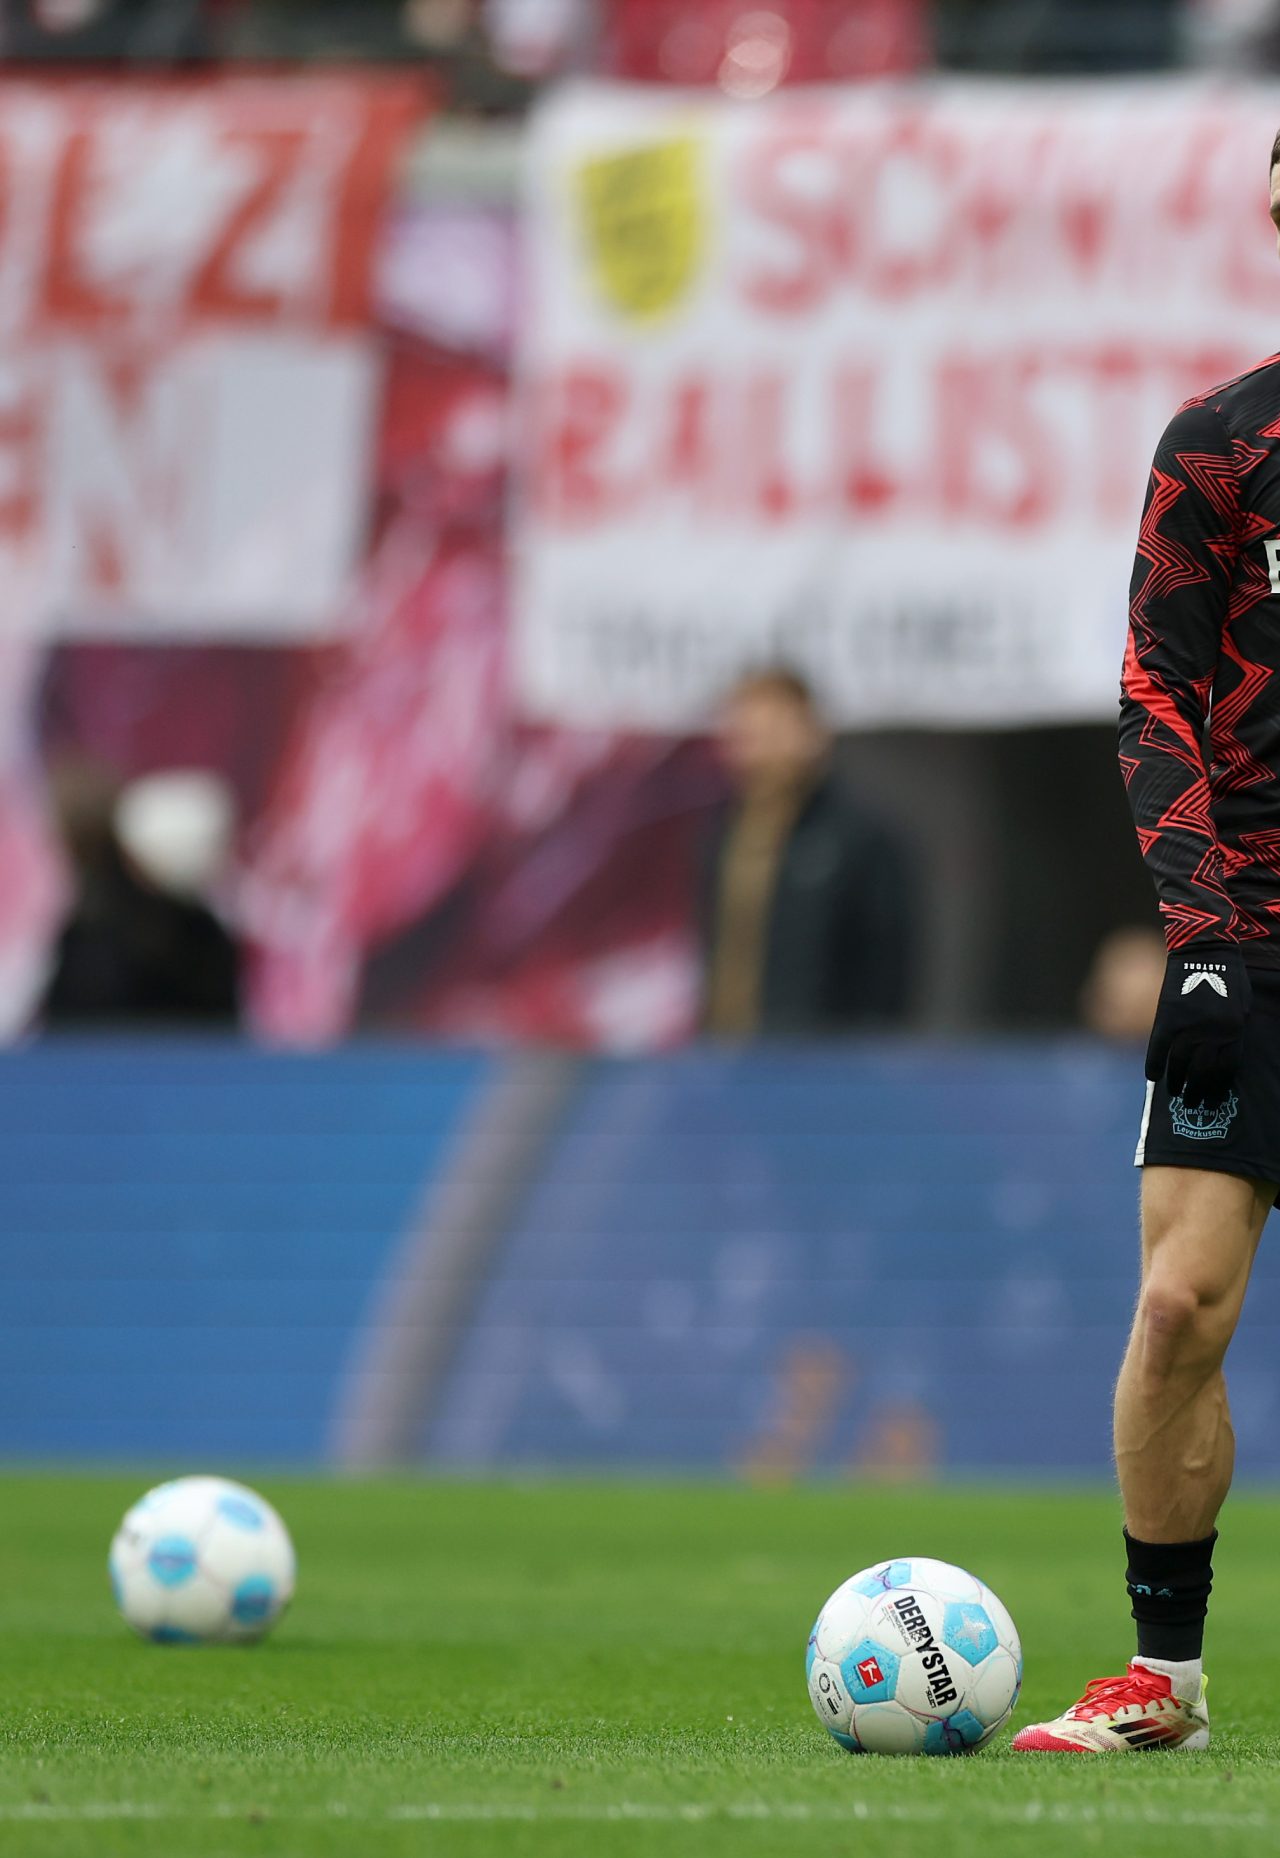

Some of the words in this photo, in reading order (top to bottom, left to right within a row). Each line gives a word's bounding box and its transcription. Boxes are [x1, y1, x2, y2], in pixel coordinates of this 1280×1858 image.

[1183, 962, 1227, 971] CASTORE
[1177, 1125, 1222, 1137] Leverkusen
[893, 1595, 958, 1706] DERBYSTAR
